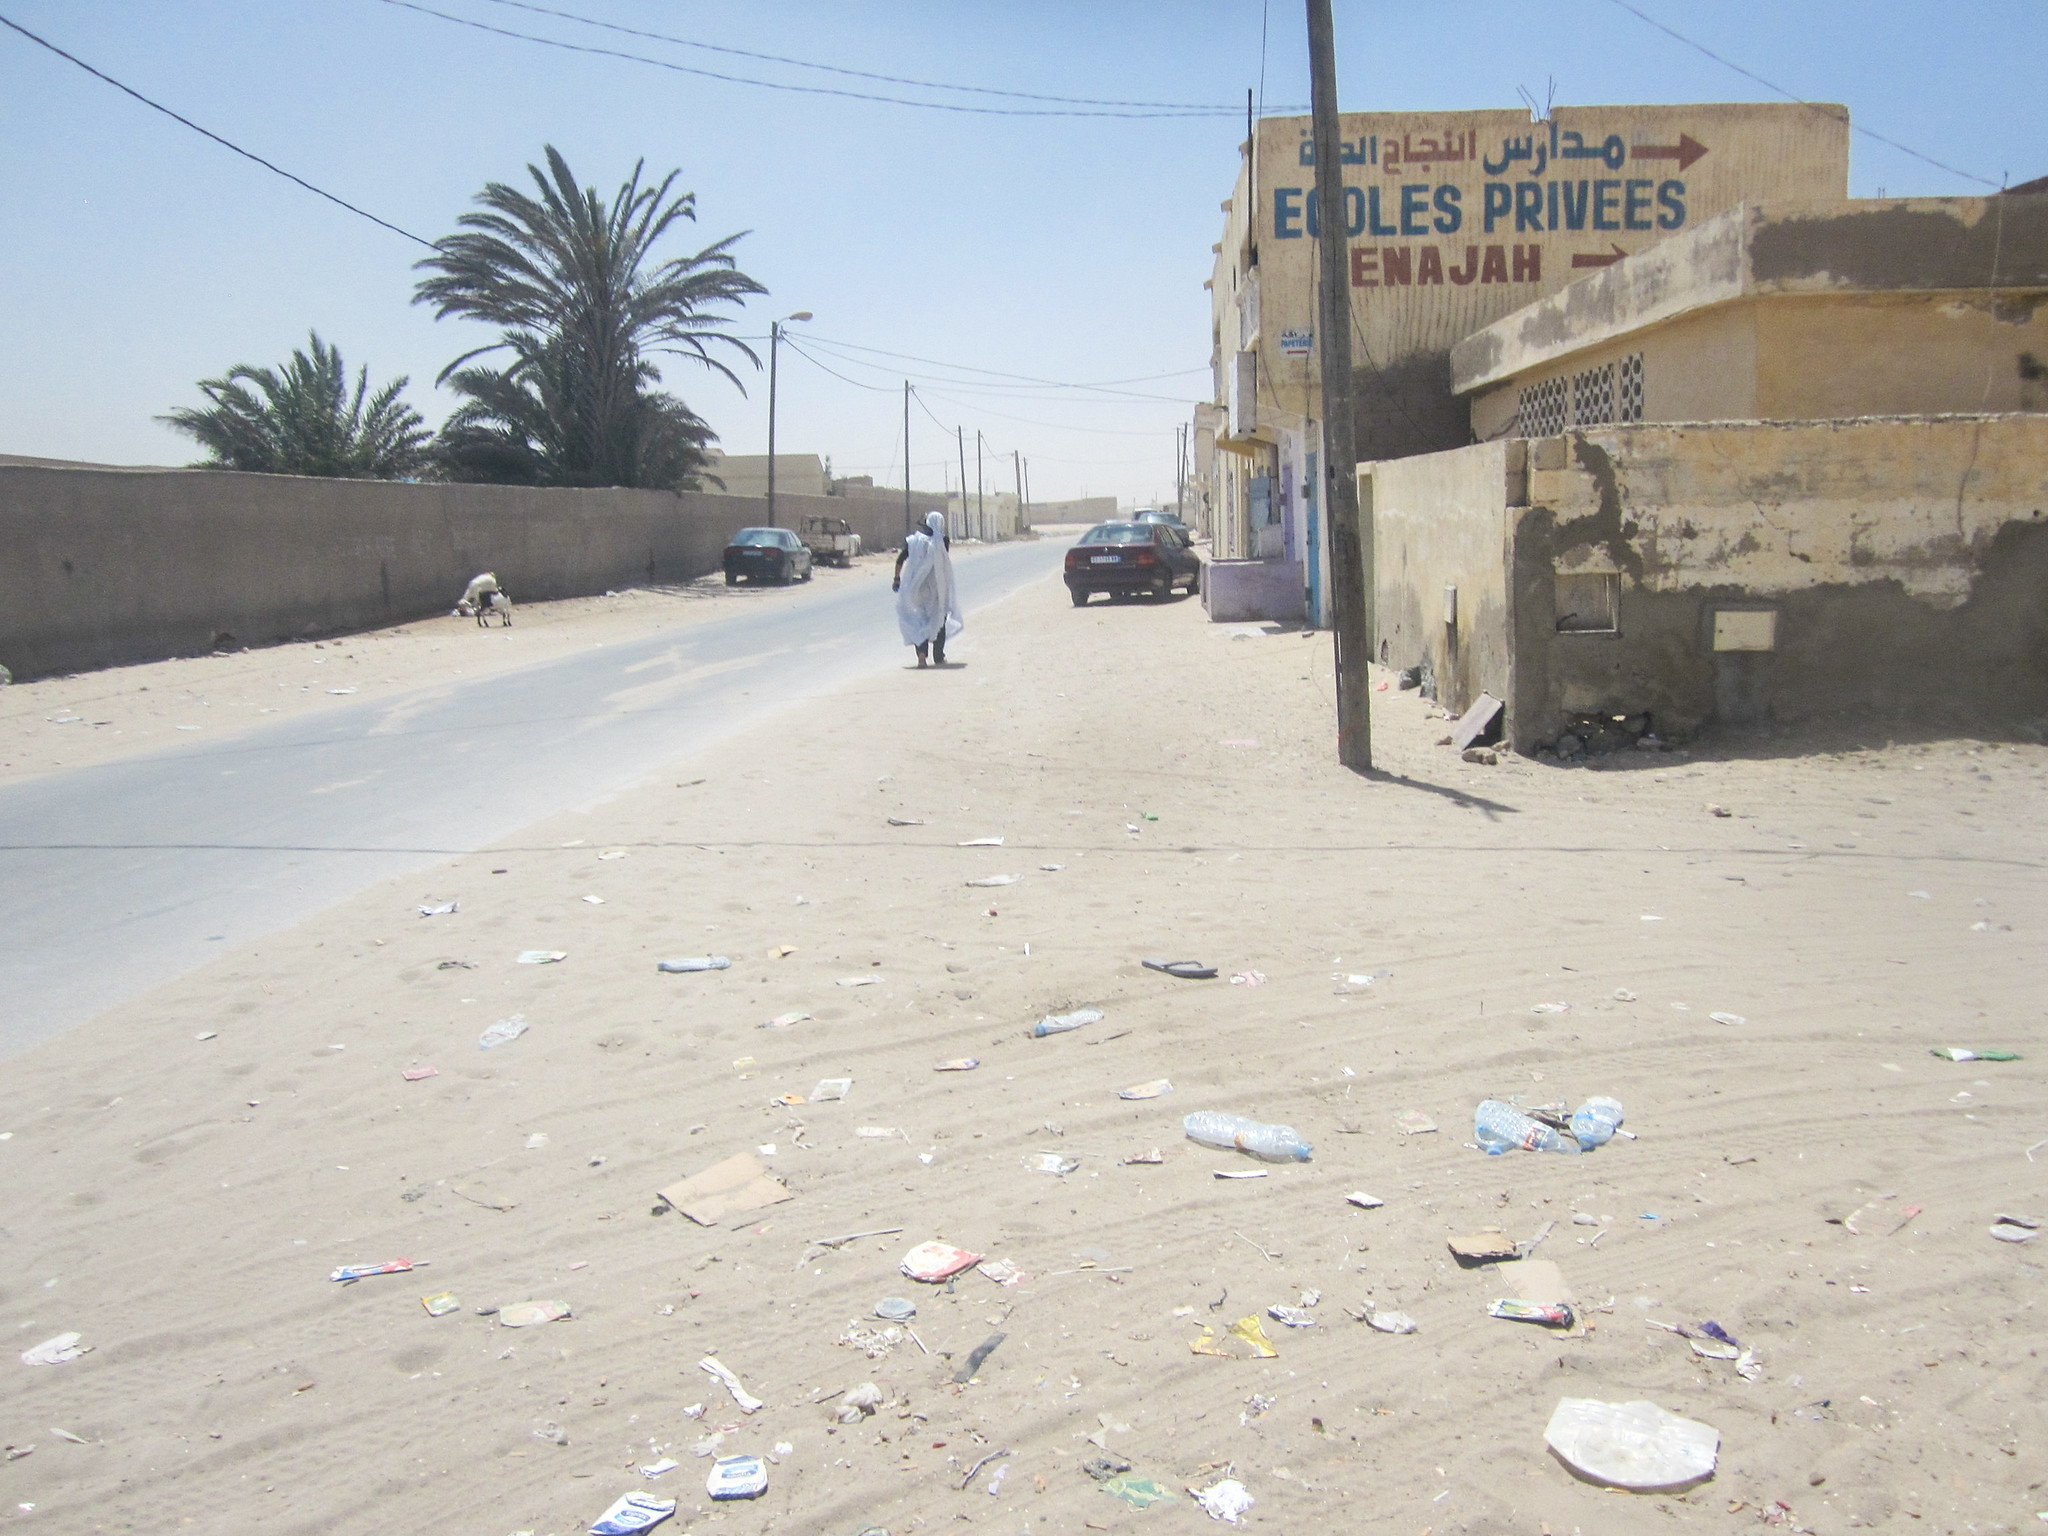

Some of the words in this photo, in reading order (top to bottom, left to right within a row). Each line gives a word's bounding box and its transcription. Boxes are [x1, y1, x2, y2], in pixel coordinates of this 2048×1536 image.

[1383, 128, 1477, 175] النجاح
[1483, 121, 1625, 176] مدارس
[1484, 179, 1686, 233] PRIVEES
[1351, 244, 1541, 288] ENAJAH
